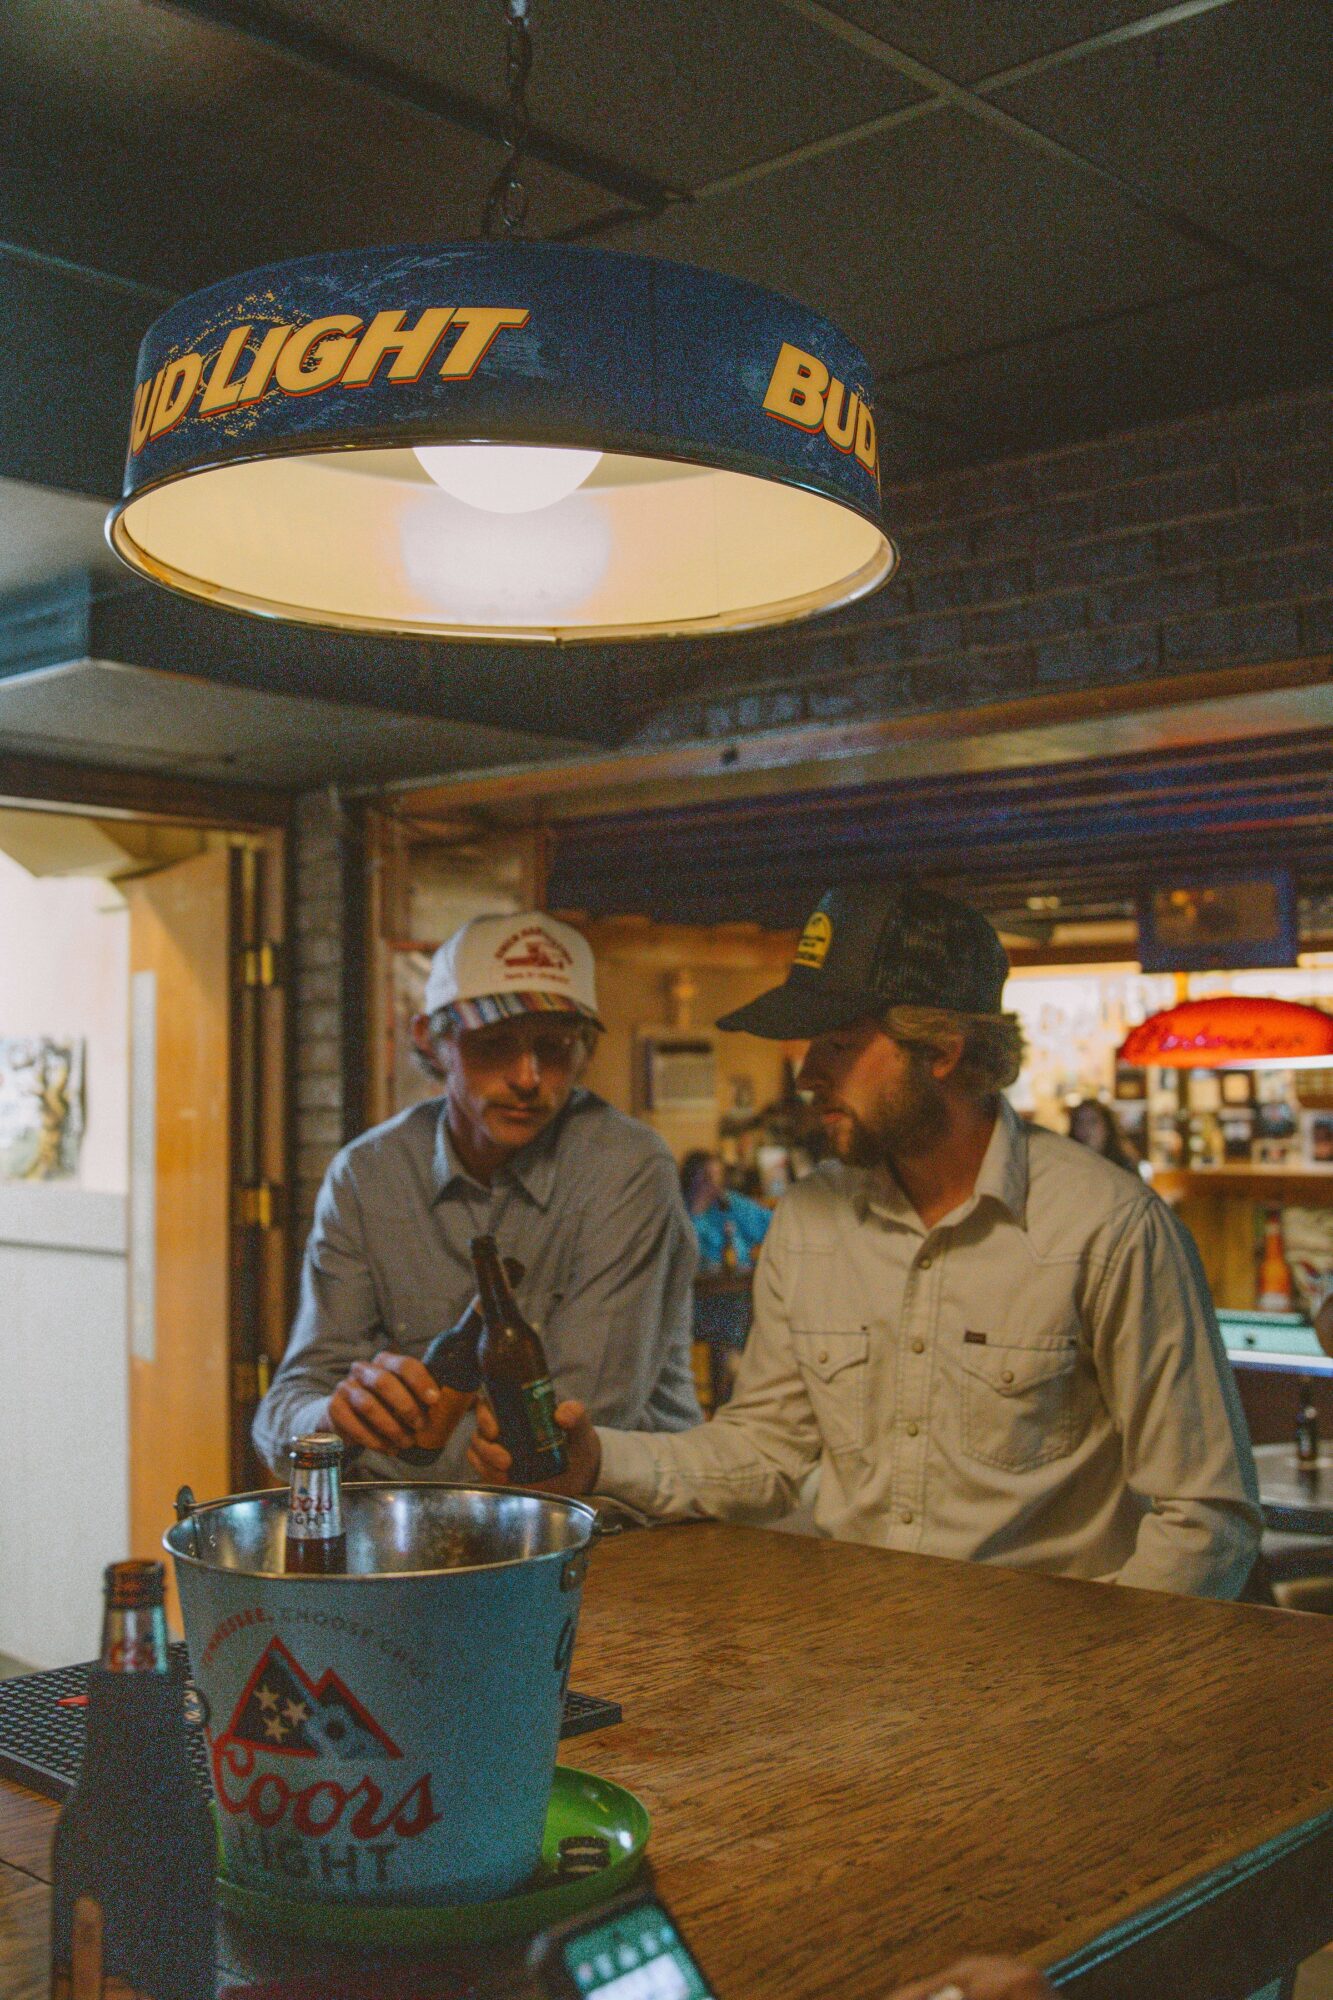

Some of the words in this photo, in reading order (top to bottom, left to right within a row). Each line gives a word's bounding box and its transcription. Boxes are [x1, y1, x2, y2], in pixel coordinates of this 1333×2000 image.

[131, 352, 203, 458] UD
[199, 306, 531, 420] LIGHT
[762, 341, 876, 476] BUD
[212, 1738, 443, 1840] Coors
